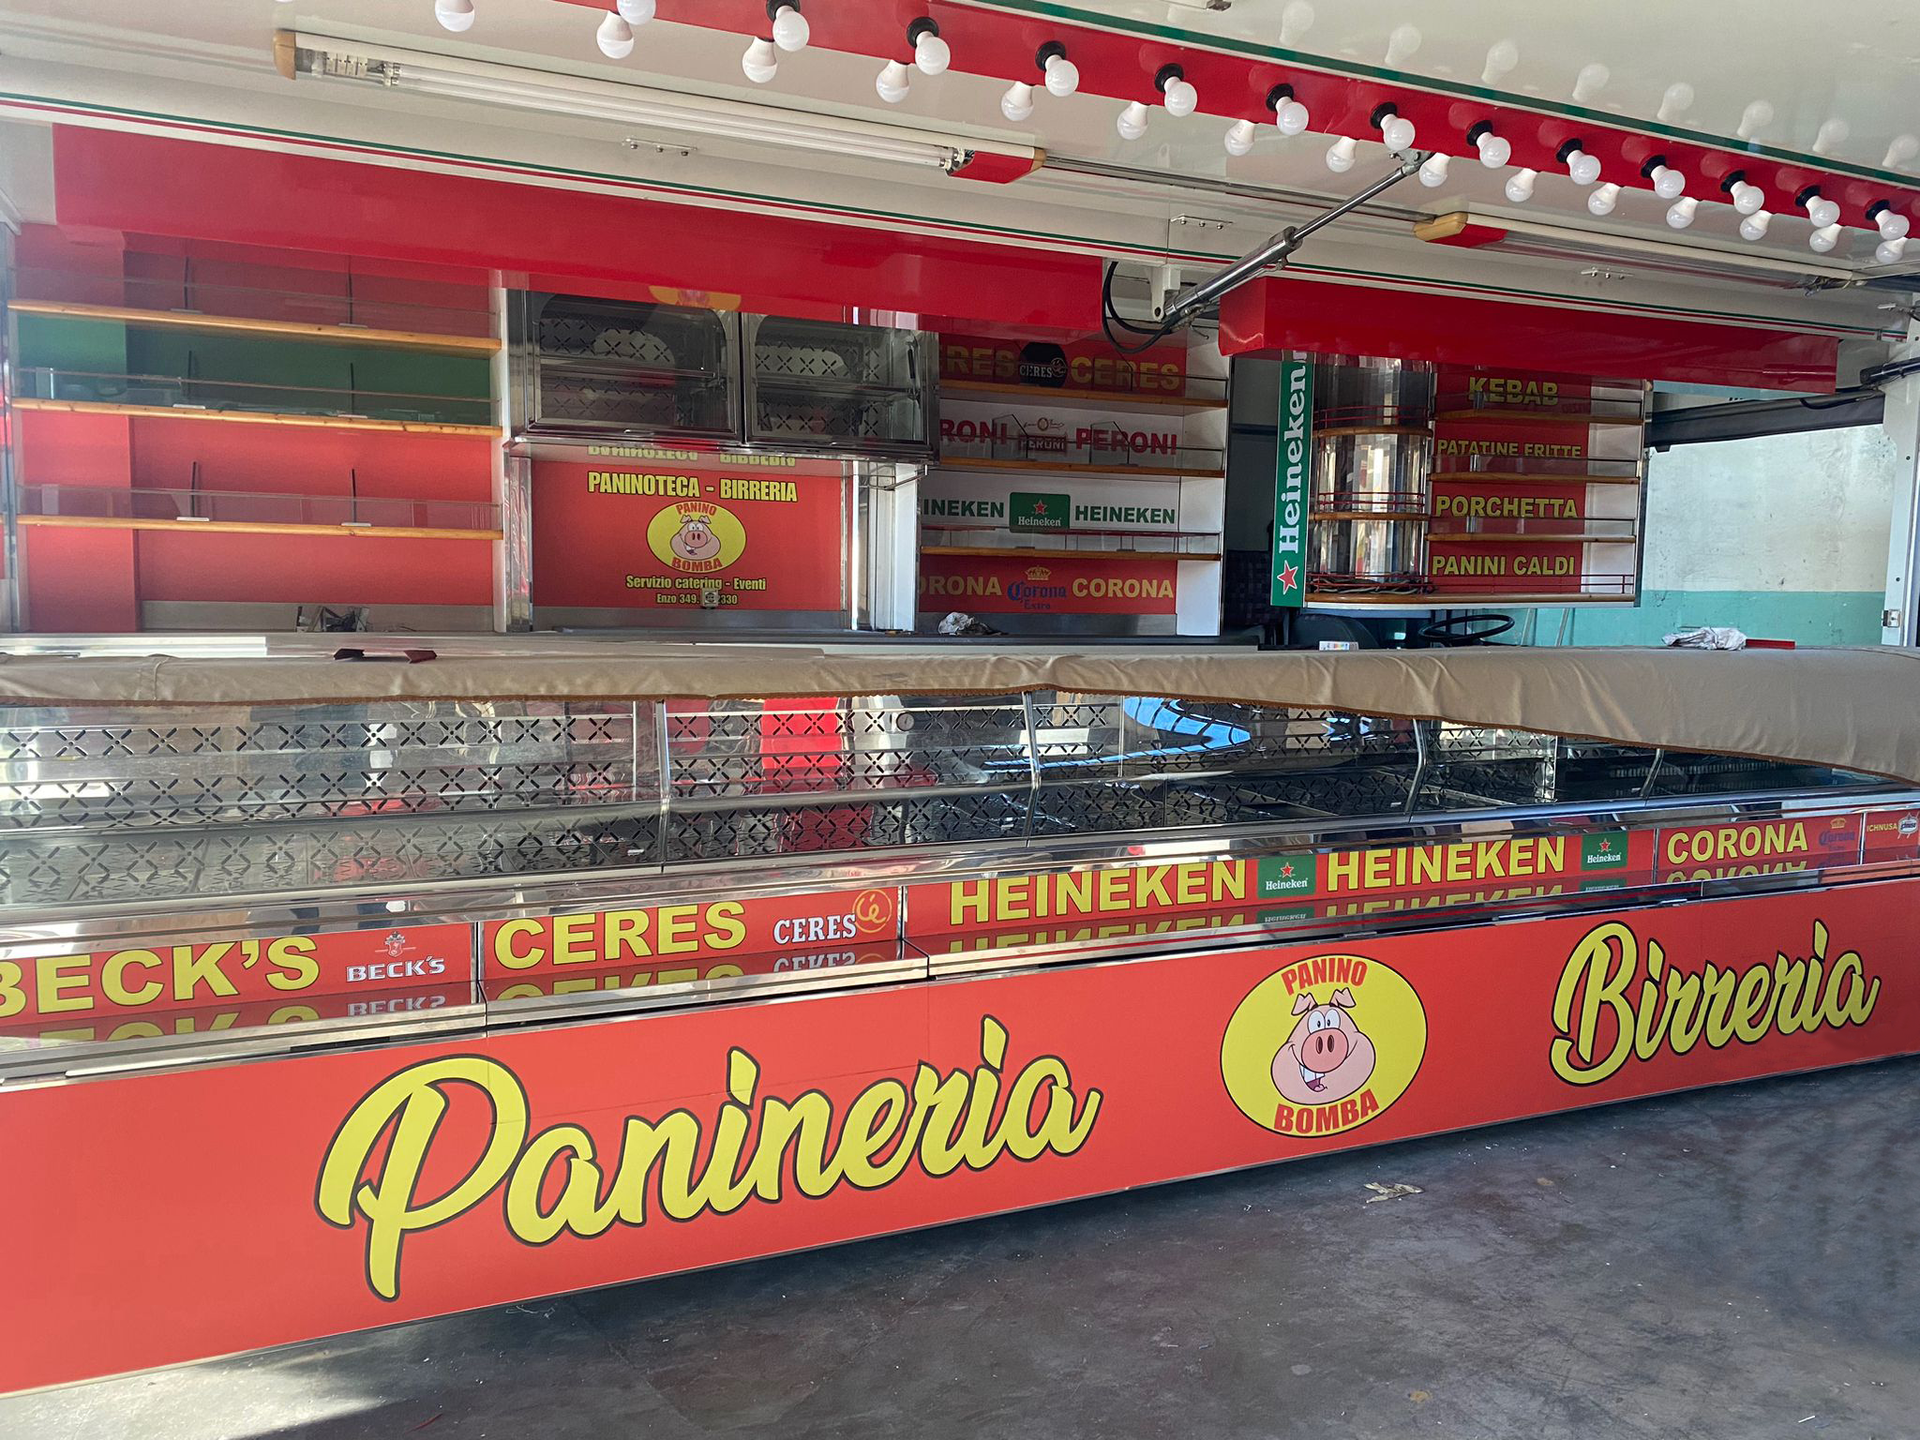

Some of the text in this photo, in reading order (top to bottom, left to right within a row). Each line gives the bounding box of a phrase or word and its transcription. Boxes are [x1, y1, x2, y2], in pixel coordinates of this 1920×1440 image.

[1019, 365, 1053, 378] CERES
[1070, 356, 1180, 391] CERES
[1468, 376, 1559, 406] KEBAB
[1020, 437, 1065, 450] PERONI
[1075, 427, 1178, 456] PERONI
[1437, 439, 1582, 458] PATATINE FRITTE
[1278, 364, 1306, 554] Heineken
[587, 471, 701, 498] PANINOTECA
[719, 478, 798, 502] BIRRERIA
[675, 502, 718, 516] PANINO
[1074, 505, 1176, 525] HEINEKEN
[1435, 495, 1579, 518] PORCHETTA
[1018, 516, 1062, 527] Heineken
[671, 557, 724, 572] BOMBA
[1431, 555, 1575, 576] PANINI CALDI
[626, 575, 672, 590] Servizio
[675, 576, 723, 592] catering
[733, 577, 767, 591] Eventi
[1007, 581, 1067, 602] Corona
[1072, 577, 1175, 599] CORONA
[656, 593, 677, 605] Enzo
[1866, 822, 1898, 833] ICHNUSA
[1667, 821, 1809, 866] CORONA
[1327, 836, 1565, 892] HEINEKEN
[1587, 853, 1621, 863] Heineken
[949, 859, 1246, 926] HEINEKEN
[1265, 879, 1309, 891] Heineken
[494, 901, 748, 970] CERES
[773, 913, 858, 945] CERES
[346, 955, 446, 983] BECK'S
[1281, 957, 1369, 996] PANINO
[1549, 918, 1882, 1087] Birreria
[1274, 1088, 1380, 1135] BOMBA
[318, 1013, 1103, 1302] Panineria
